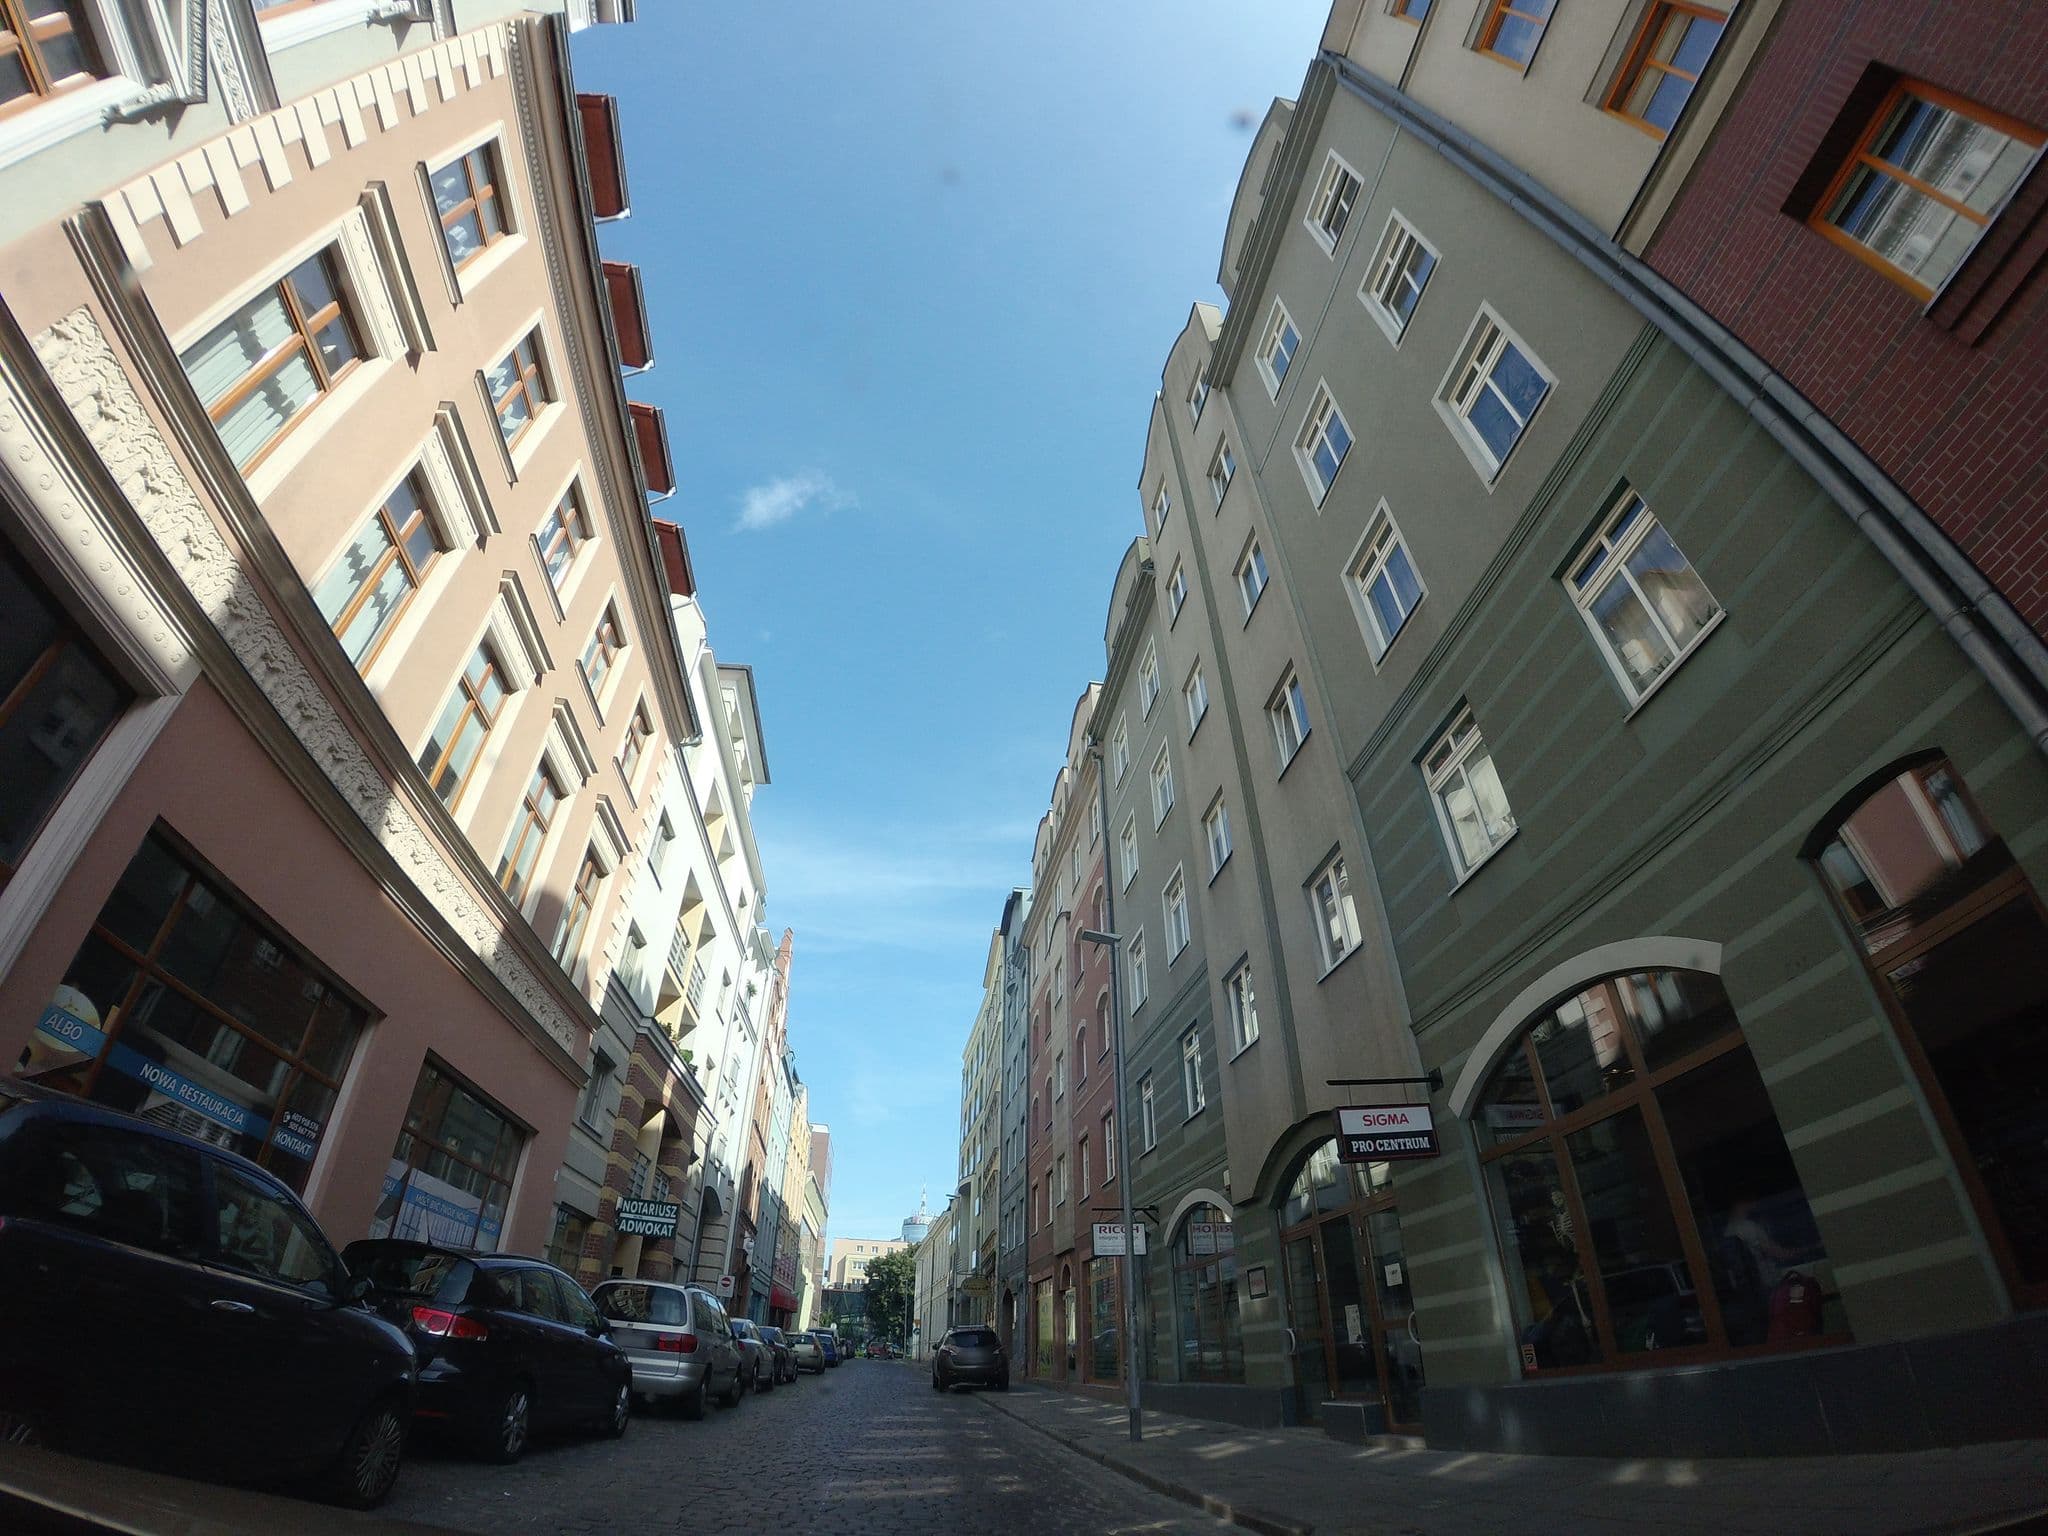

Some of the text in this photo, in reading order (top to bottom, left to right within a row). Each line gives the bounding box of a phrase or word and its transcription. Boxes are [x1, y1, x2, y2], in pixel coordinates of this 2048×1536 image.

[45, 1013, 83, 1041] ALBO
[140, 1063, 245, 1126] NOWA RESTAURACJA
[1362, 1113, 1410, 1127] SIGMA
[274, 1130, 312, 1156] KONTAKT
[1350, 1137, 1431, 1153] PRO CENTRUM
[622, 1200, 678, 1219] NOTARIUSZ
[618, 1219, 675, 1238] ADWOKAT
